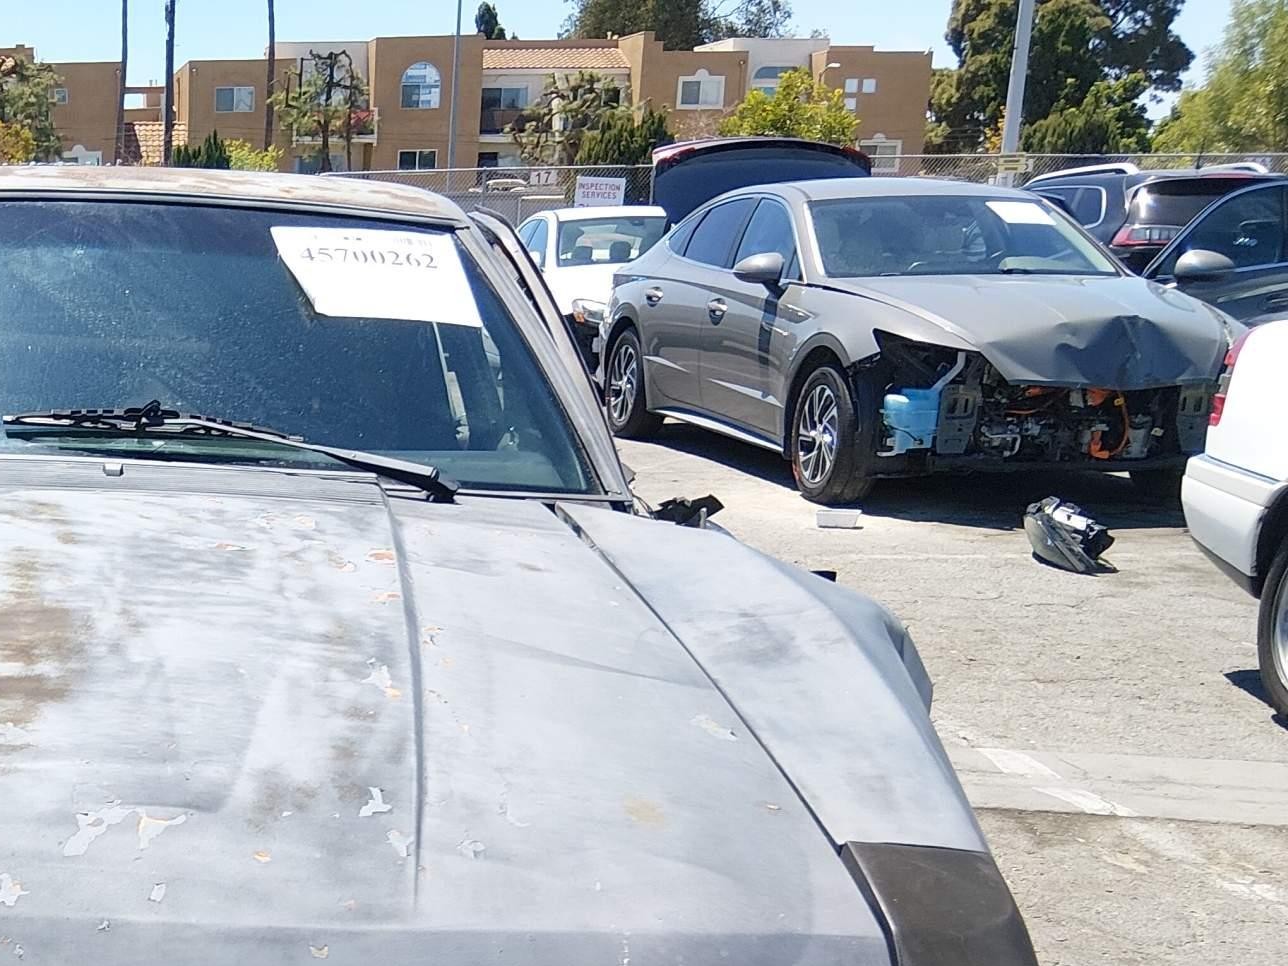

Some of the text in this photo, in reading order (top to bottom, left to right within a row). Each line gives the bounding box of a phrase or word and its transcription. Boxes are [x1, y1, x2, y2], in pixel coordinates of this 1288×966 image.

[535, 171, 552, 184] 17
[578, 182, 621, 192] INSPECTION
[581, 191, 617, 199] SERVICES
[300, 246, 438, 270] 45700262
